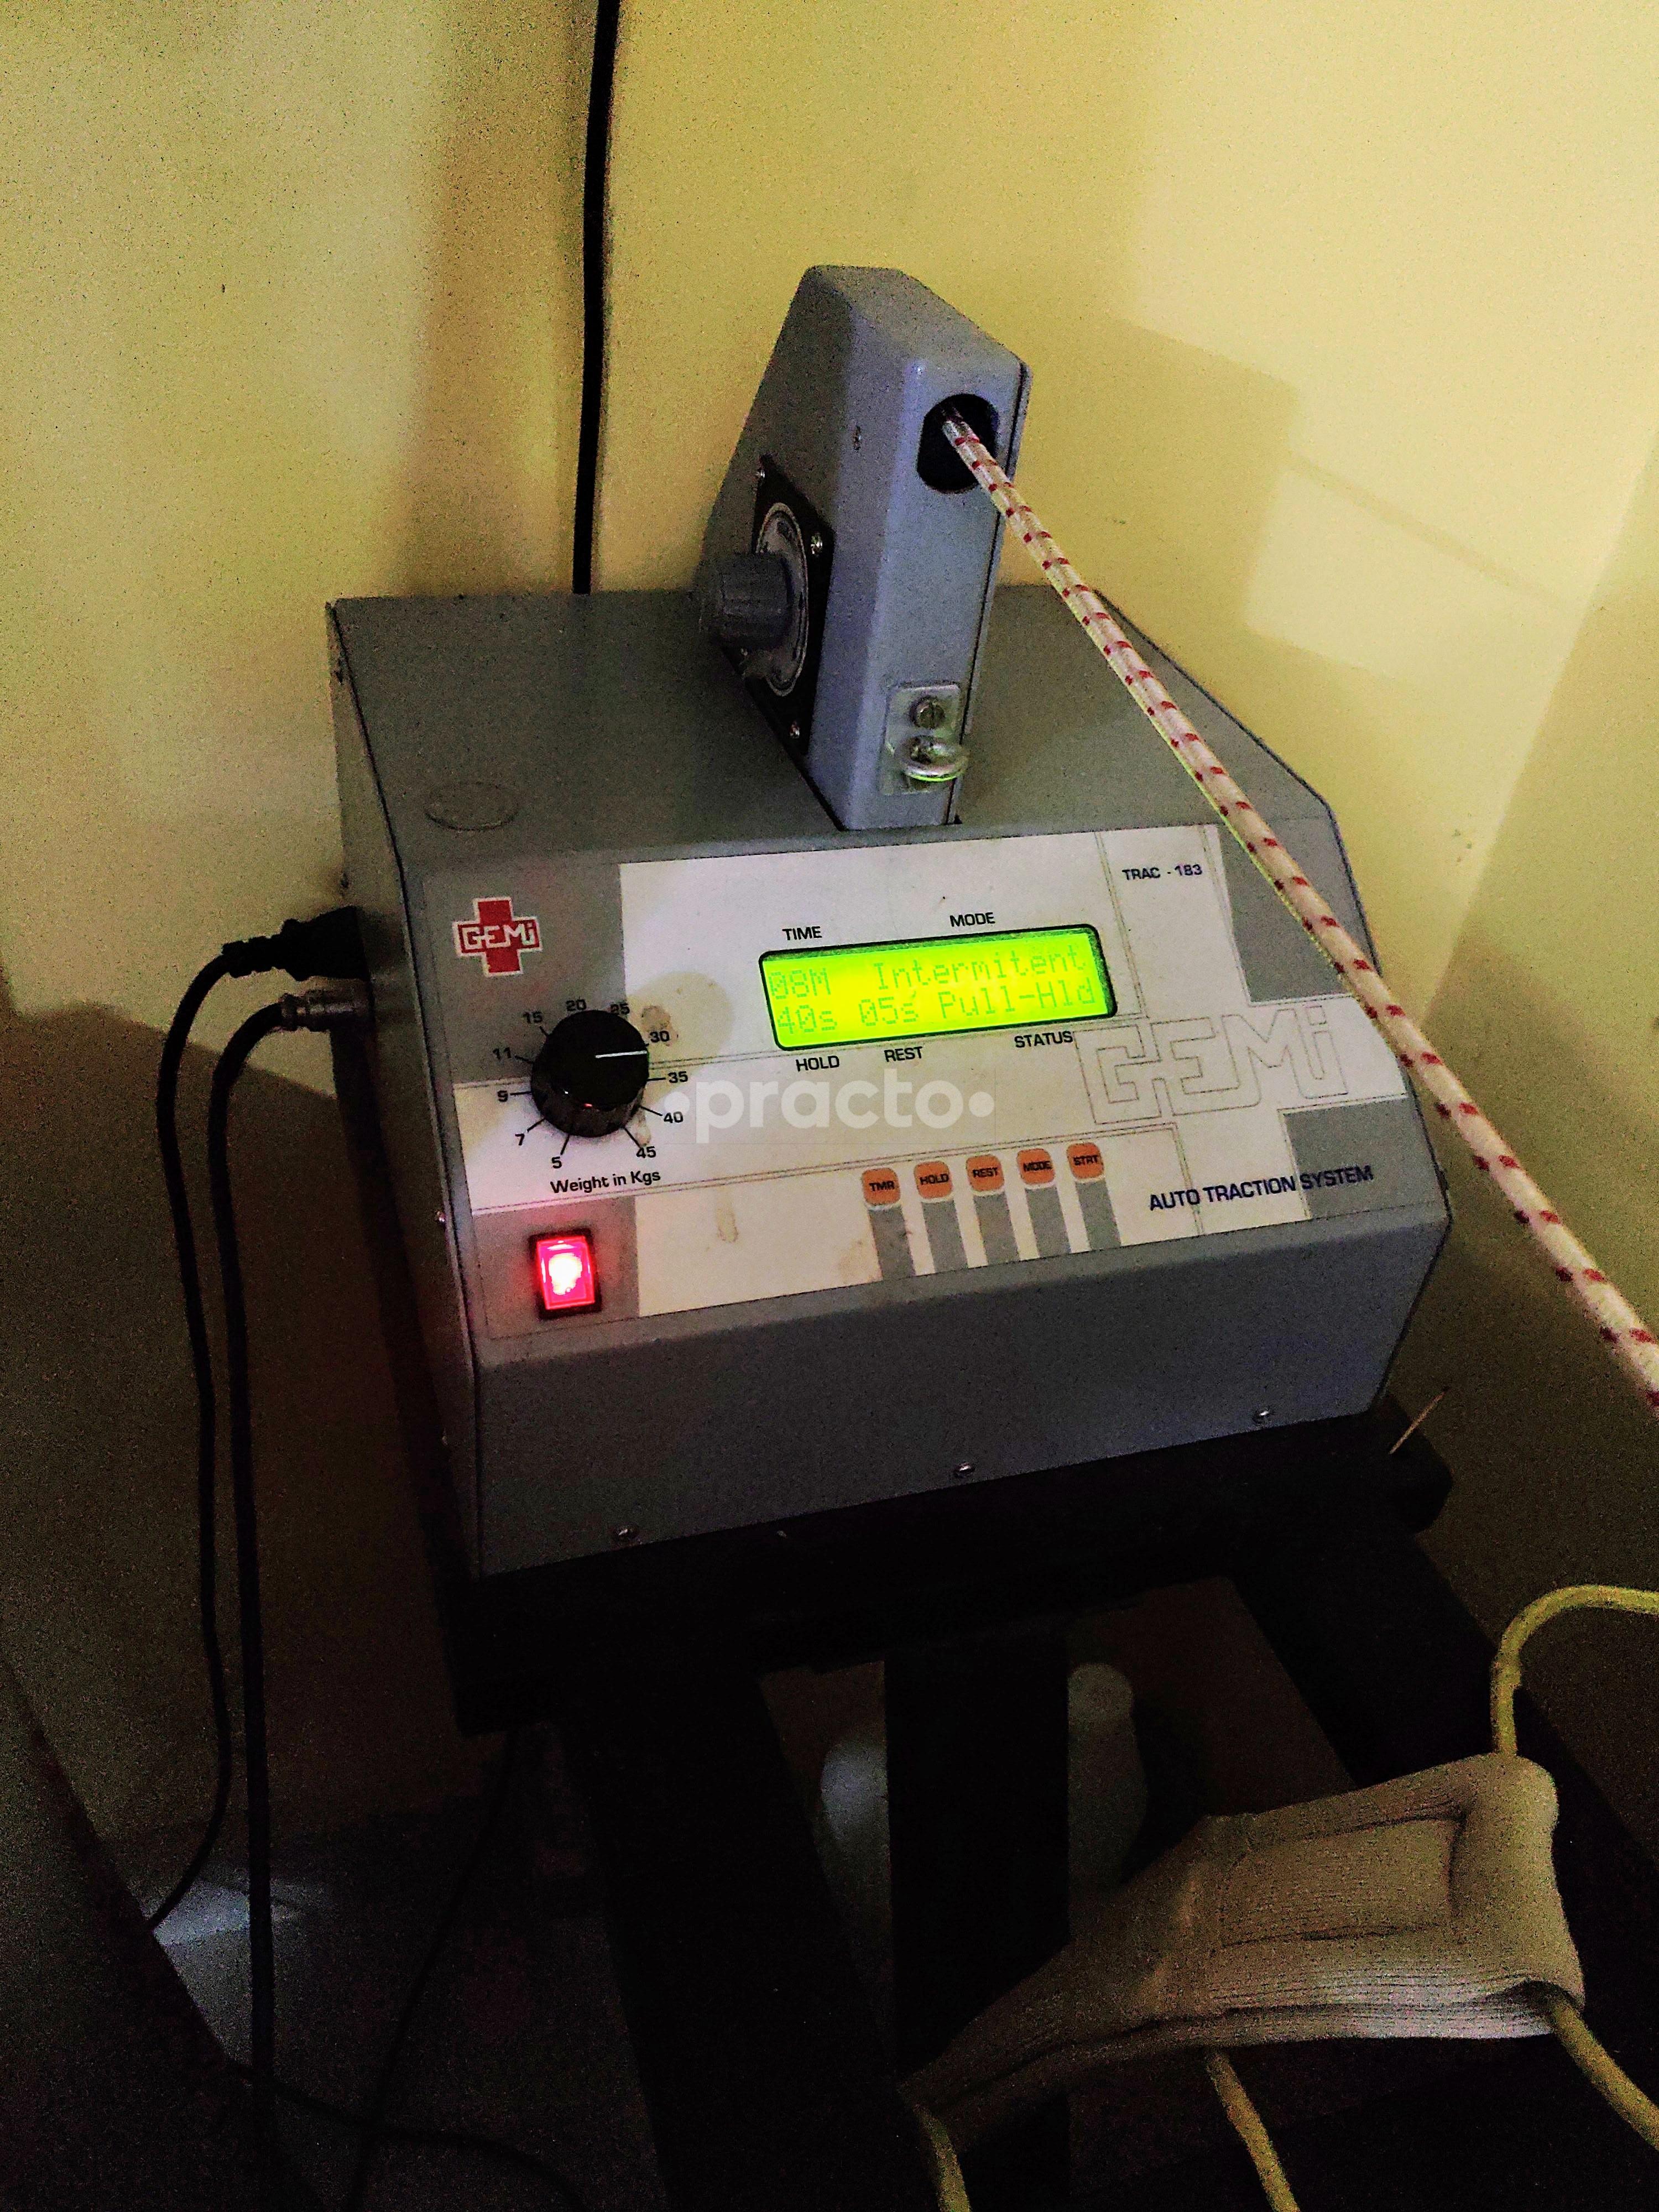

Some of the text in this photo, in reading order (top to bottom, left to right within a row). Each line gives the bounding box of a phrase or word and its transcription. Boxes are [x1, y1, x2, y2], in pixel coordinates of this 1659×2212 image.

[1123, 867, 1160, 880] TRAC
[1175, 863, 1203, 877] 183
[950, 912, 995, 927] MODE
[782, 926, 822, 941] TIME
[769, 945, 1086, 1000] 08M Intermitent
[566, 999, 586, 1011] 20
[611, 1002, 630, 1015] 25
[778, 979, 1096, 1035] 40s 05s Pull-Hld
[523, 1011, 542, 1024] 15
[650, 1030, 670, 1043] 30
[1014, 1031, 1073, 1048] STATUS
[493, 1047, 512, 1060] 11
[884, 1046, 923, 1062] REST
[796, 1055, 840, 1072] HOLD
[668, 1071, 688, 1083] 35
[498, 1091, 508, 1102] 9
[664, 1112, 684, 1124] 40
[515, 1134, 525, 1146] 7
[637, 1146, 656, 1158] 45
[551, 1156, 562, 1168] 5
[1022, 1160, 1051, 1172] MODE
[920, 1173, 949, 1185] HOLD
[972, 1167, 998, 1178] REST
[550, 1170, 661, 1193] Weight in Kgs
[869, 1182, 895, 1192] TMR
[1149, 1165, 1374, 1211] AUTO TRACTION SYSTEM
